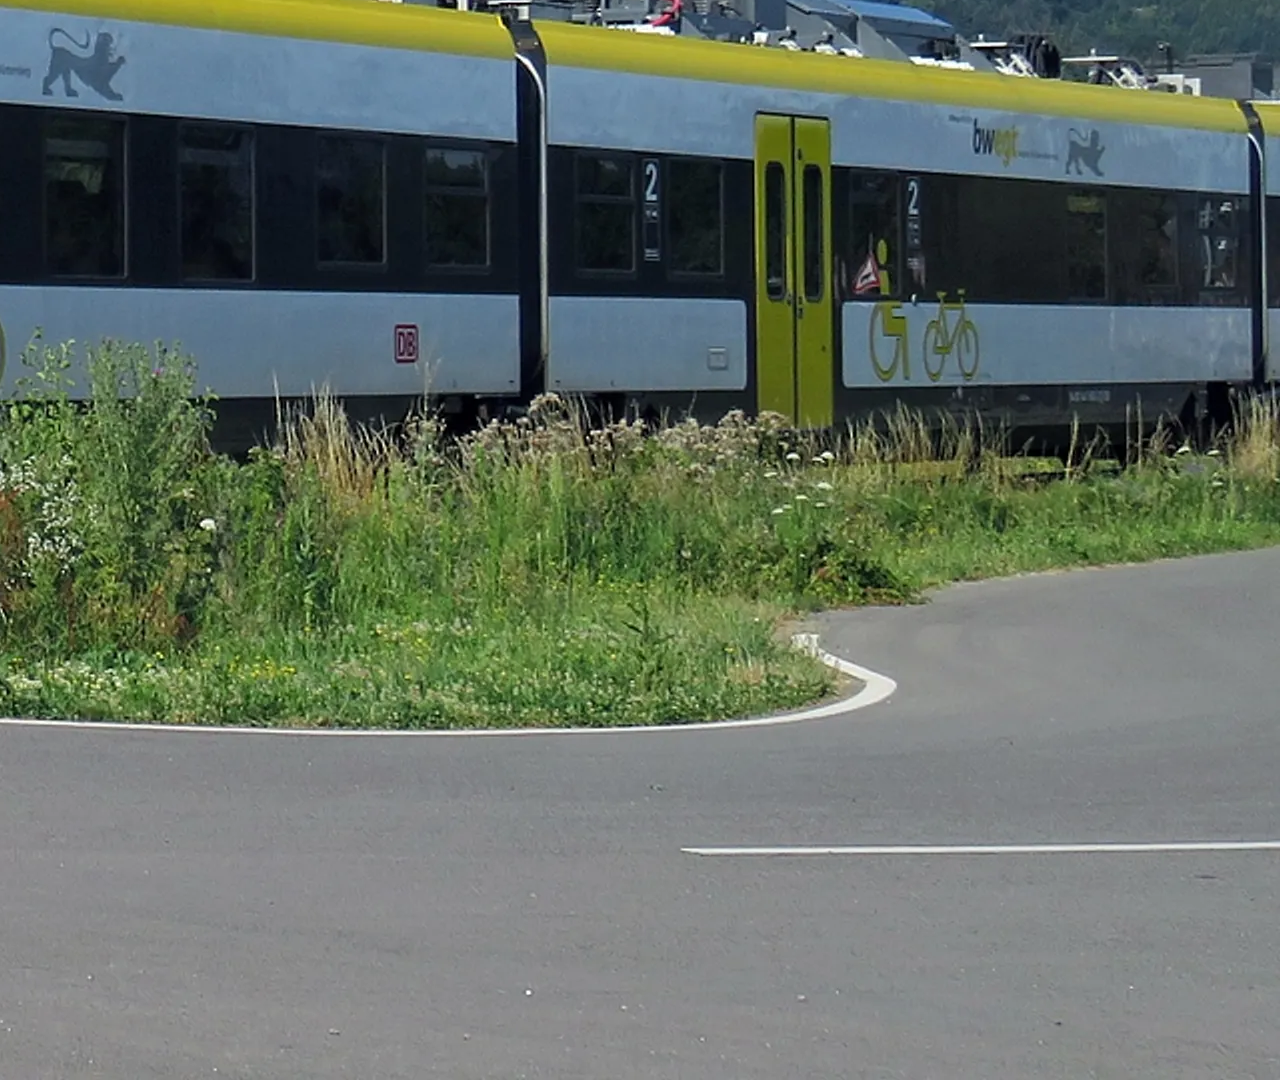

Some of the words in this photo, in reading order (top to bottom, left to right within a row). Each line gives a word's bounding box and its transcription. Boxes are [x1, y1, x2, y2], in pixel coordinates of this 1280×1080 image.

[645, 163, 658, 201] 2
[907, 180, 919, 215] 2
[397, 329, 417, 358] DB
